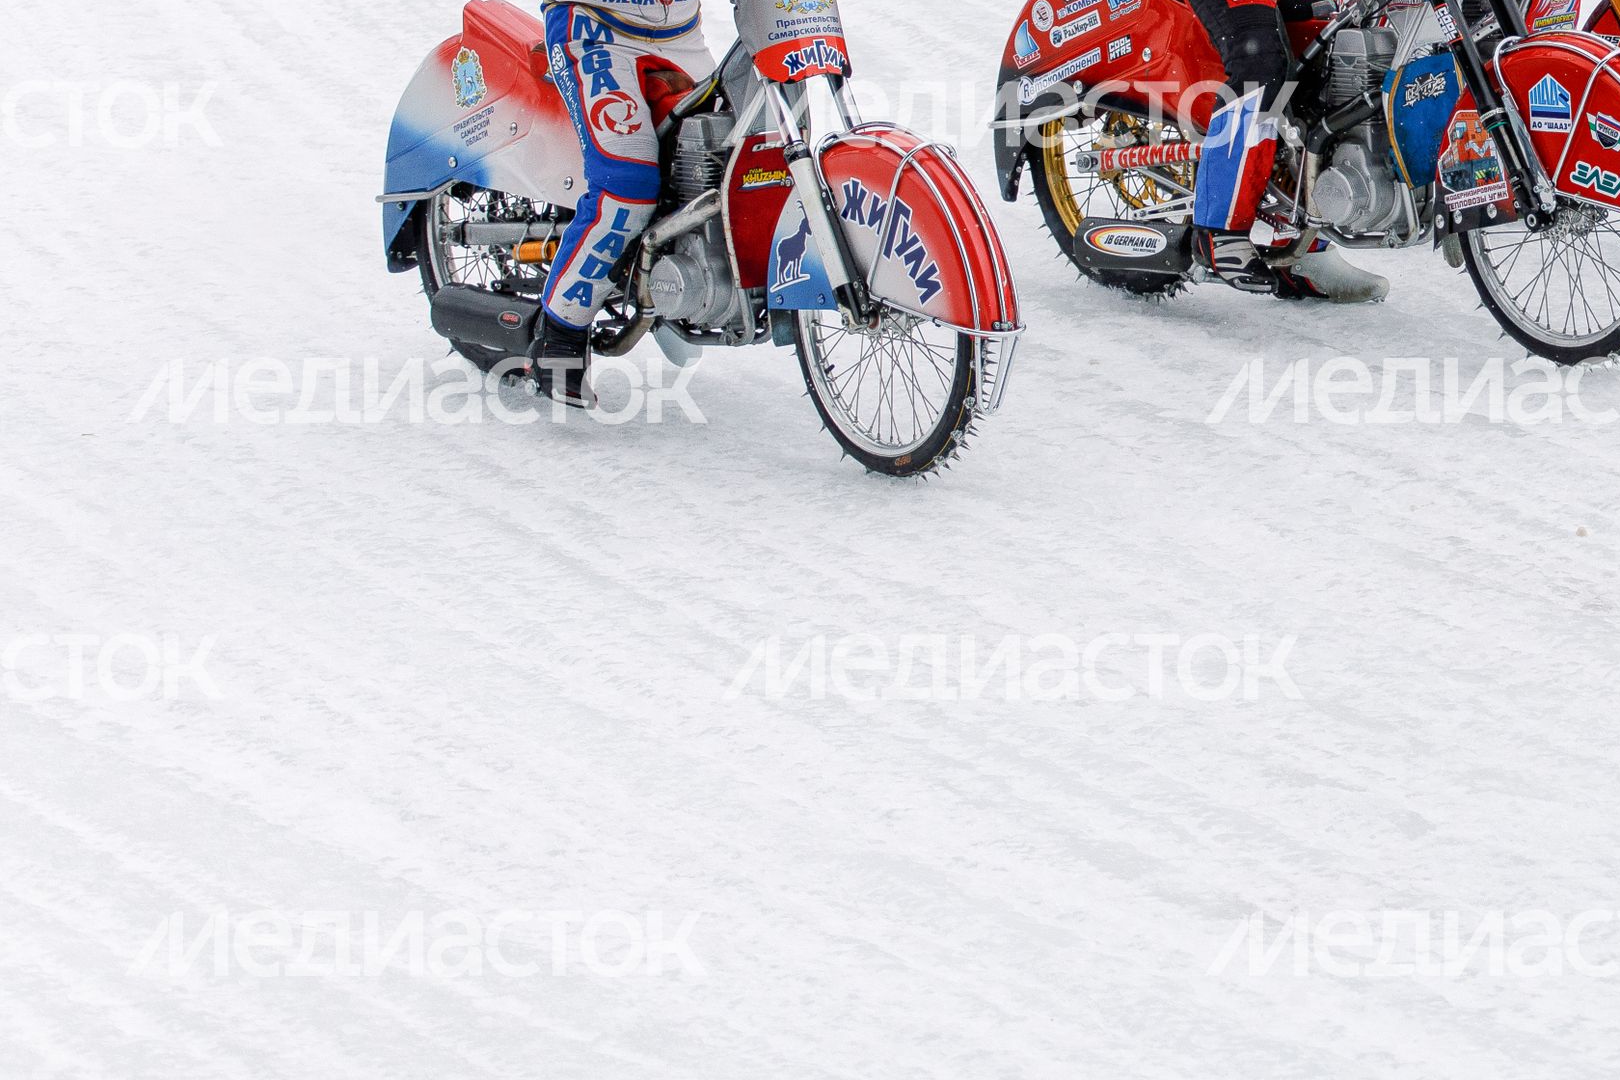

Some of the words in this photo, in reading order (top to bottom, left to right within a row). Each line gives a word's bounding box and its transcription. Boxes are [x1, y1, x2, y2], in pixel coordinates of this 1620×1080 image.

[768, 26, 821, 41] Самарской
[1108, 36, 1131, 53] COOL
[1109, 44, 1132, 61] MTRS
[1118, 140, 1191, 169] GERMAN
[1114, 235, 1146, 248] GERMAN
[1145, 237, 1158, 249] OIL
[562, 207, 632, 308] LADA
[650, 280, 677, 293] JAWA
